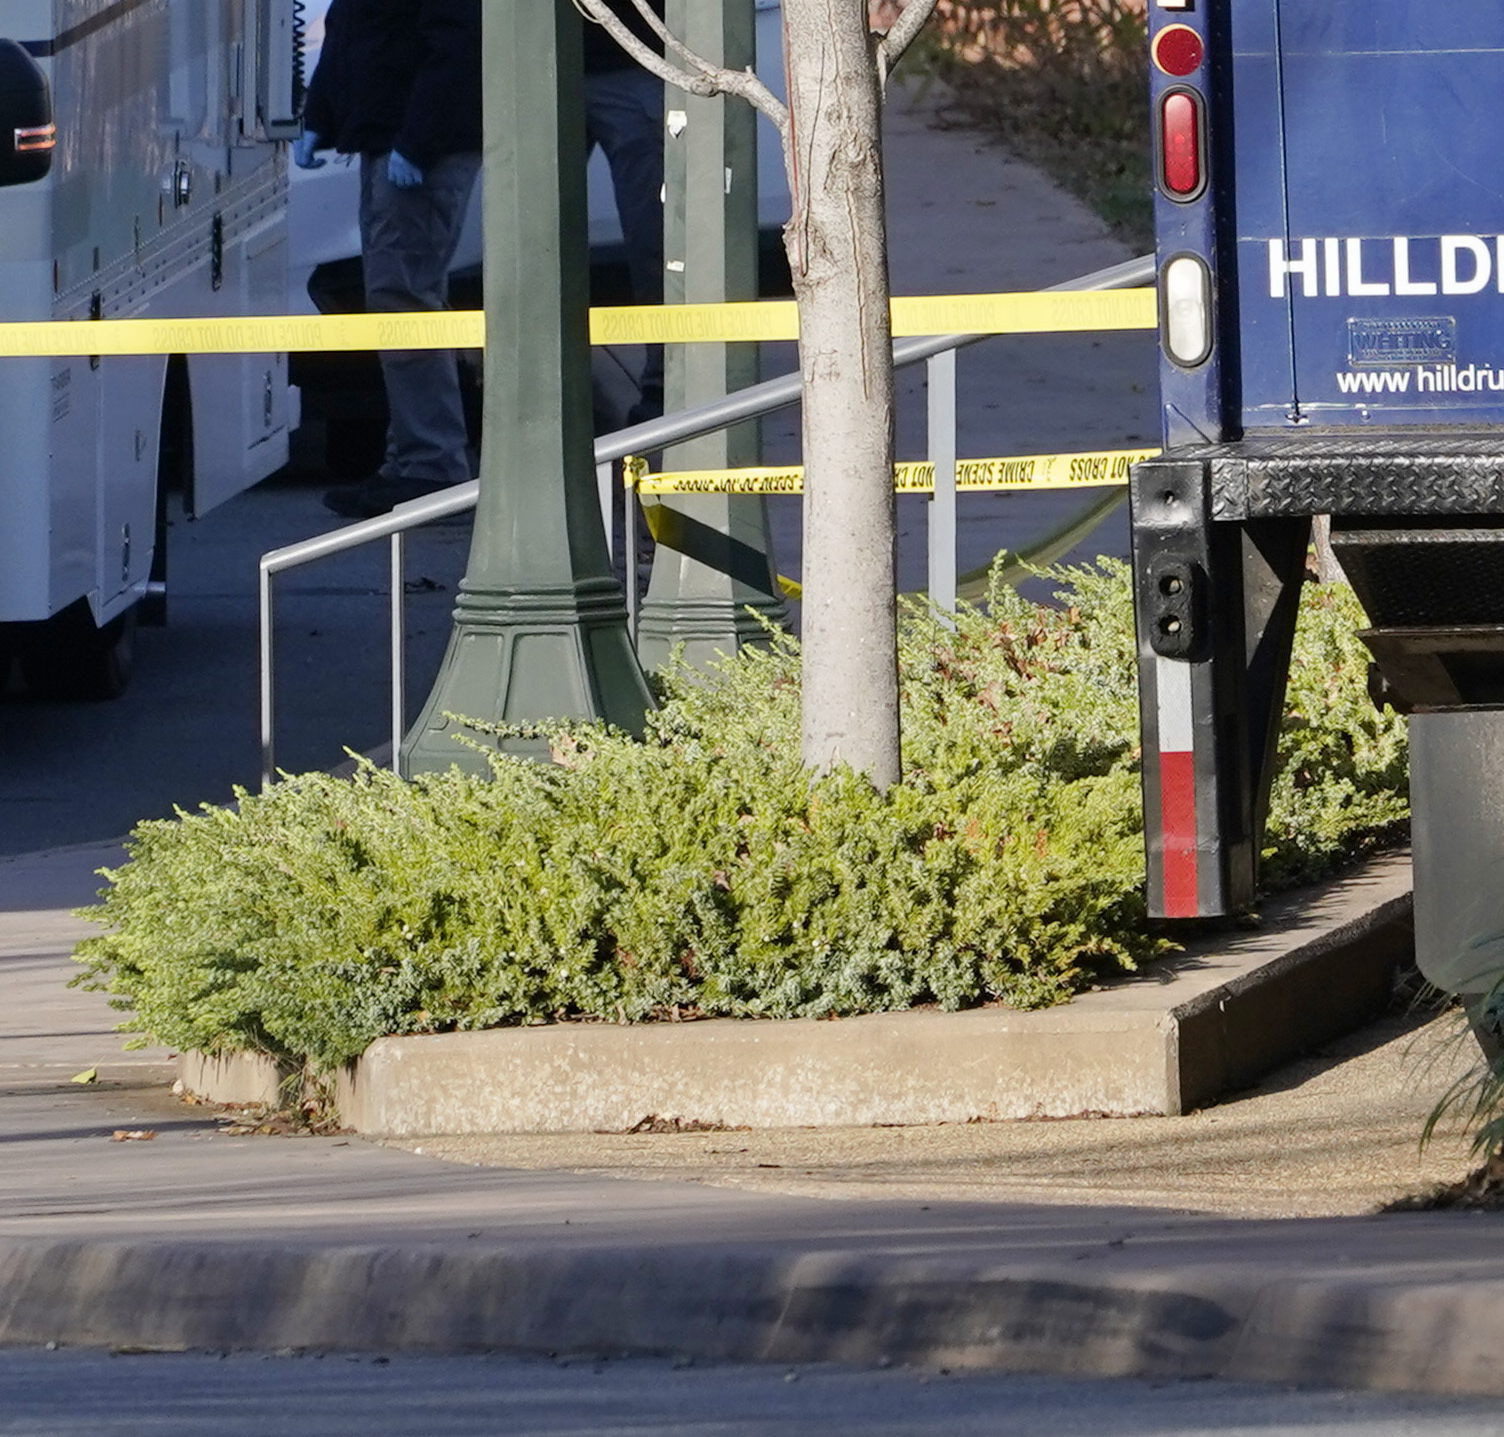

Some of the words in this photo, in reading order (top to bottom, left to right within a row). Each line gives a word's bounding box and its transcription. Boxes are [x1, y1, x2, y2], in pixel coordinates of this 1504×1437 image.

[955, 461, 993, 486] SCENE
[998, 459, 1036, 485] CRIME
[1068, 456, 1107, 482] CROSS
